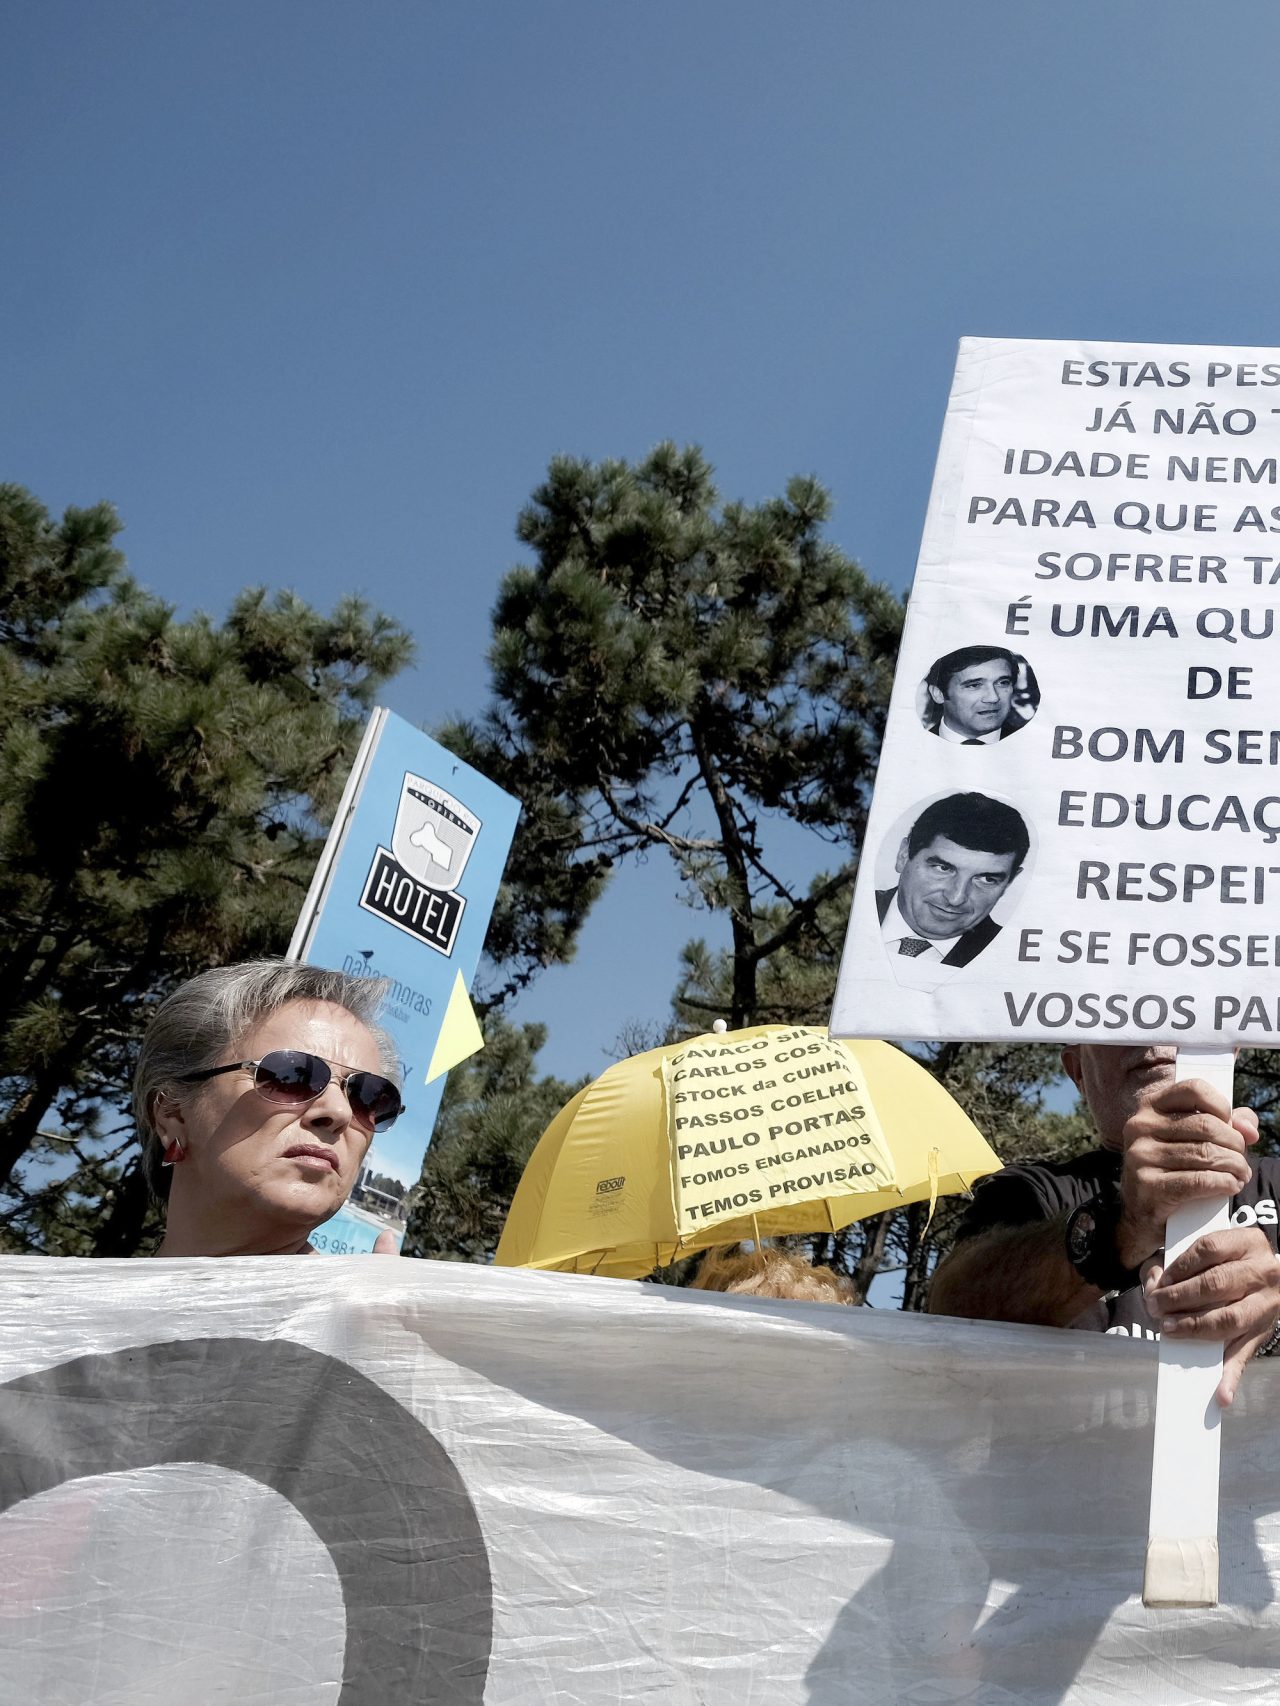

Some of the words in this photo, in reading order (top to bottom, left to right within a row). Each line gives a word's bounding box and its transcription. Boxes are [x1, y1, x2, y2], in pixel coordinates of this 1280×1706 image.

[1062, 360, 1191, 387] ESTAS
[1085, 400, 1136, 433] JÁ
[1155, 405, 1257, 435] NÃO
[1004, 450, 1149, 479] IDADE
[1168, 457, 1276, 484] NEM
[968, 497, 1096, 528] PARA
[1114, 502, 1217, 533] QUE
[1035, 552, 1227, 583] SOFRER
[1006, 596, 1032, 635] É
[1051, 604, 1178, 638] UMA
[1187, 667, 1252, 699] DE
[1052, 726, 1184, 763] BOM
[374, 864, 451, 943] HOTEL
[1019, 929, 1043, 961] E
[1058, 929, 1109, 965] SE
[1004, 992, 1195, 1030] VOSSOS
[672, 1041, 768, 1066] CAVACO
[674, 1059, 767, 1082] CARLOS
[675, 1084, 746, 1103] STOCK
[753, 1080, 776, 1091] da
[676, 1105, 763, 1129] PASSOS
[771, 1081, 858, 1111] COELHO
[678, 1133, 760, 1160] PAULO
[769, 1106, 866, 1140] PORTAS
[681, 1164, 749, 1188] FOMOS
[756, 1134, 871, 1169] ENGANADOS
[685, 1189, 762, 1220] TEMOS
[769, 1162, 876, 1198] PROVISÃO
